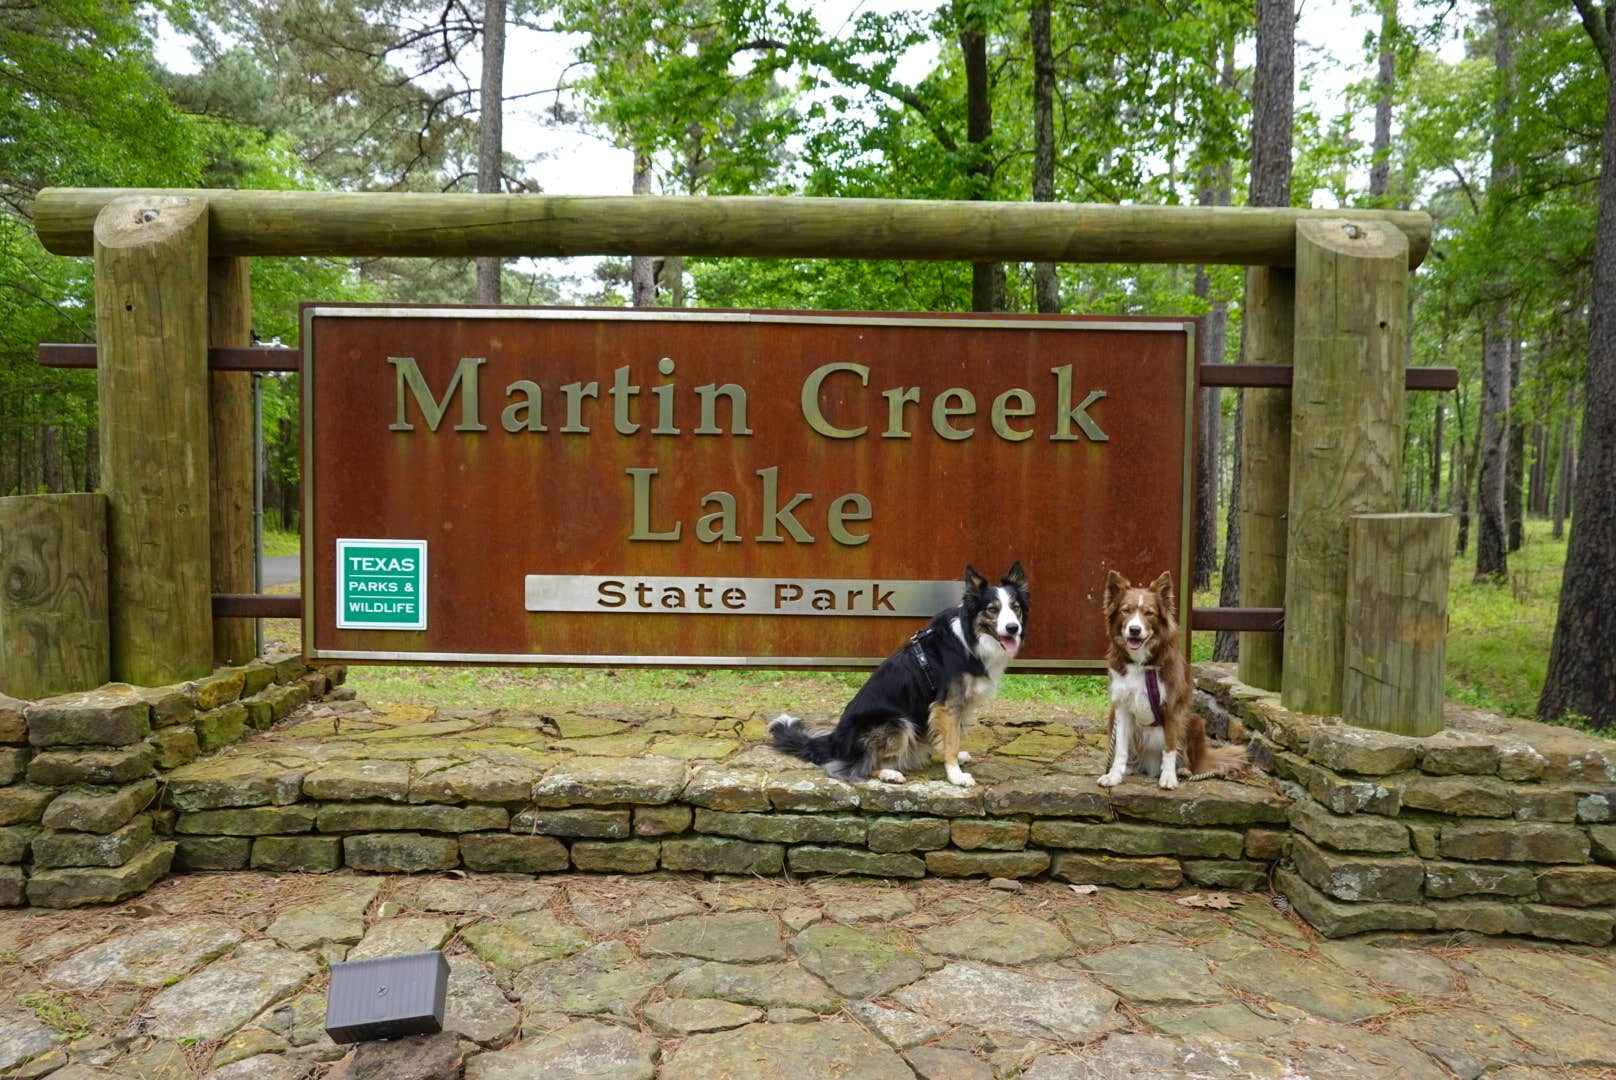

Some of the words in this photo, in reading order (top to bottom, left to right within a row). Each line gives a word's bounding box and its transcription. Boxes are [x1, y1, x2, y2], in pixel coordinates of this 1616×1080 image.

[387, 356, 753, 436] Martin
[801, 362, 1110, 442] Creek
[625, 465, 873, 545] Lake
[349, 557, 415, 572] TEXAS
[348, 581, 398, 592] PARKS
[404, 582, 414, 592] &
[597, 580, 747, 609] State
[773, 583, 897, 611] Park
[349, 602, 415, 613] WILDLIFE
